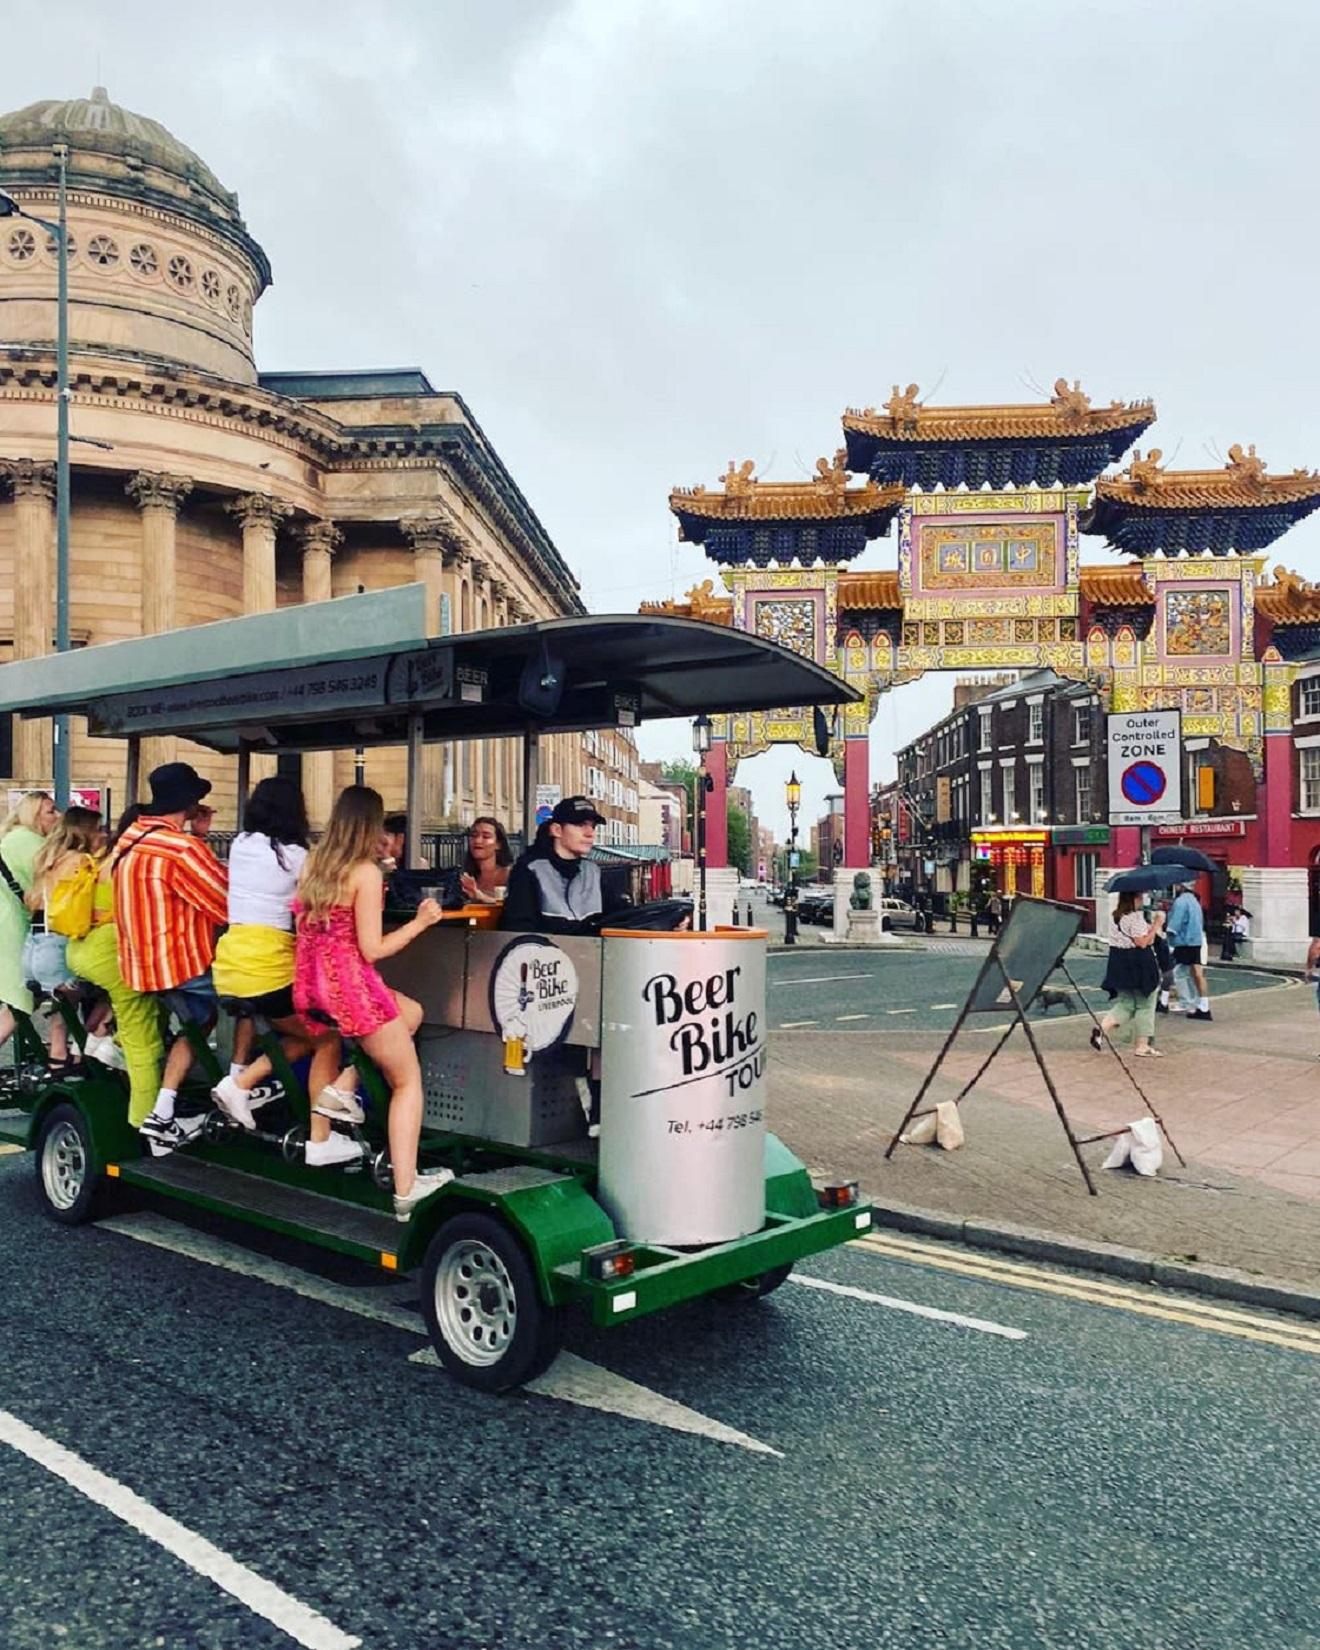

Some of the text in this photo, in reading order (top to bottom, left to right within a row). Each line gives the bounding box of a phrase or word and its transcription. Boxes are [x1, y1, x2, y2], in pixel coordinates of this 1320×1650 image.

[456, 666, 488, 685] BEER
[1126, 718, 1160, 729] Outer
[1112, 730, 1175, 742] Controlled
[1121, 744, 1166, 758] ZONE
[1190, 823, 1235, 834] RESTAURANT
[529, 959, 560, 979] Beer
[537, 979, 568, 999] Bike
[642, 966, 741, 1025] Beer
[670, 1012, 758, 1075] Bike
[667, 1120, 692, 1134] Tel.
[698, 1118, 724, 1131] +44
